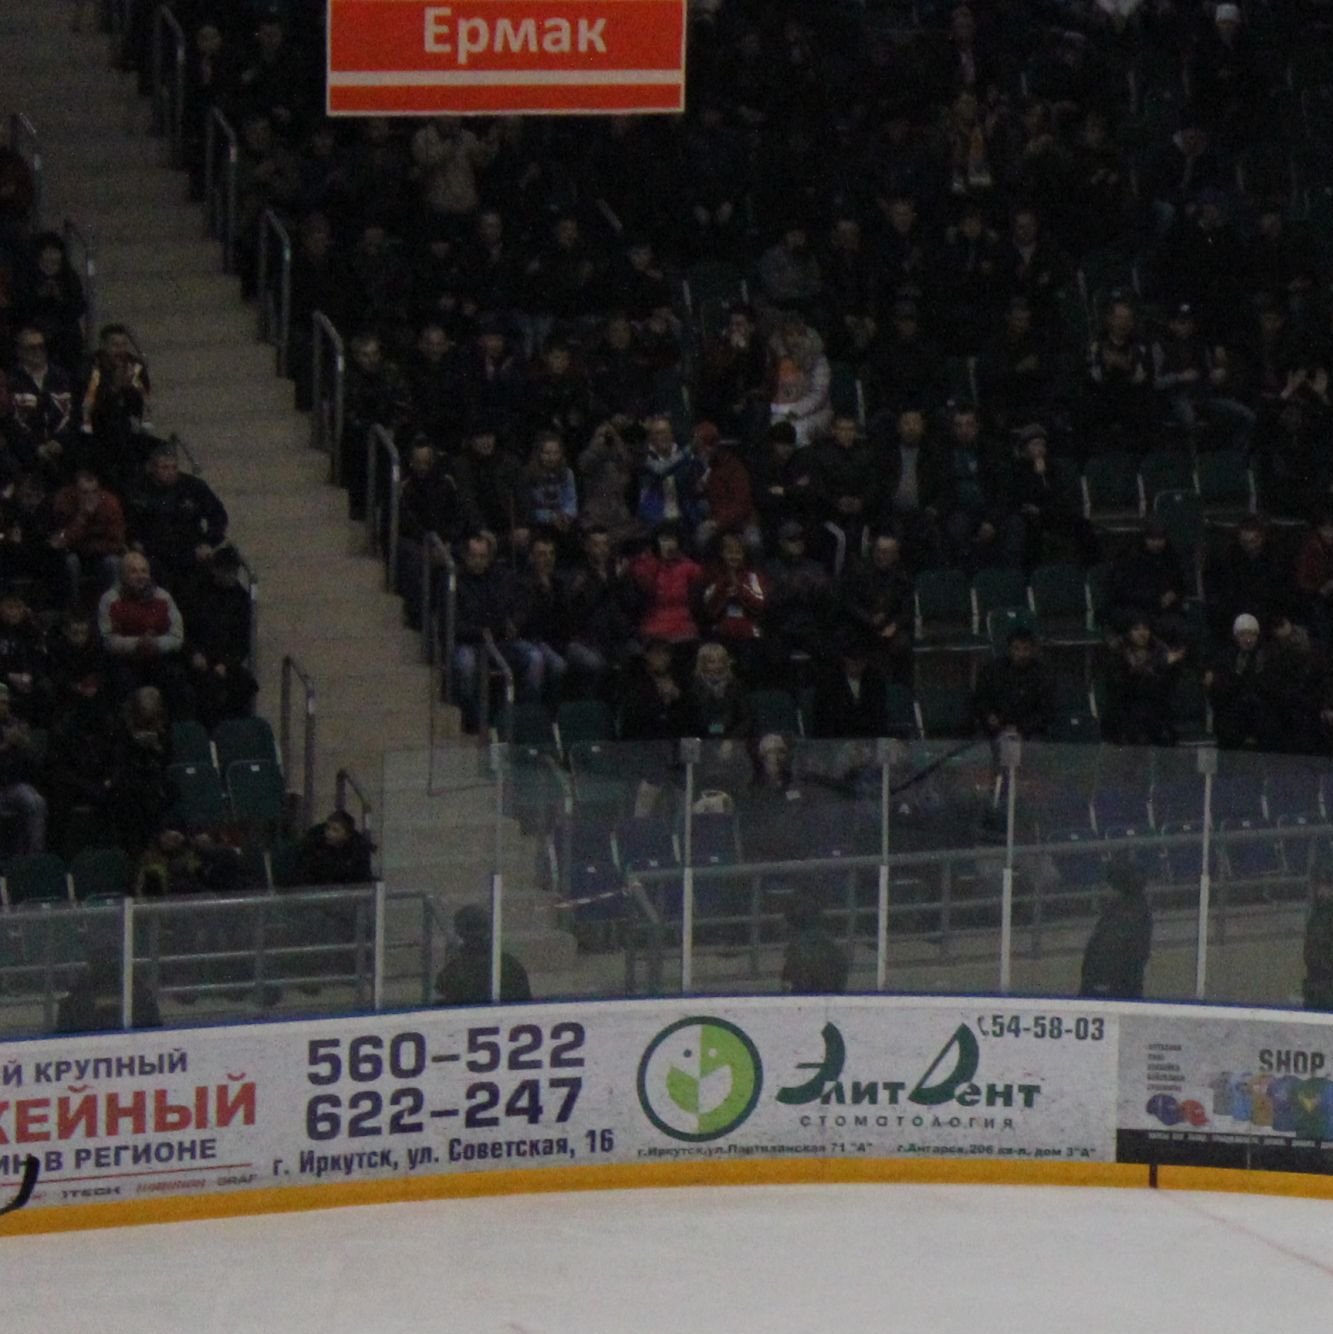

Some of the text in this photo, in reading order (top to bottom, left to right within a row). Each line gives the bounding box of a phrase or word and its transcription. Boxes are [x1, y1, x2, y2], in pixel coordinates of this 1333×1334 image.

[423, 6, 608, 65] Ермак
[991, 1015, 1105, 1041] 54-58-03
[34, 1047, 189, 1083] КРУПНЫЙ
[307, 1021, 587, 1087] 560-522
[305, 1076, 584, 1141] 622-247
[45, 1150, 64, 1172] В
[74, 1137, 217, 1169] РЕГИОНЕ
[299, 1147, 393, 1177] Иркутск,
[407, 1145, 440, 1170] ул.
[448, 1136, 576, 1167] Советская,
[586, 1129, 615, 1155] 16
